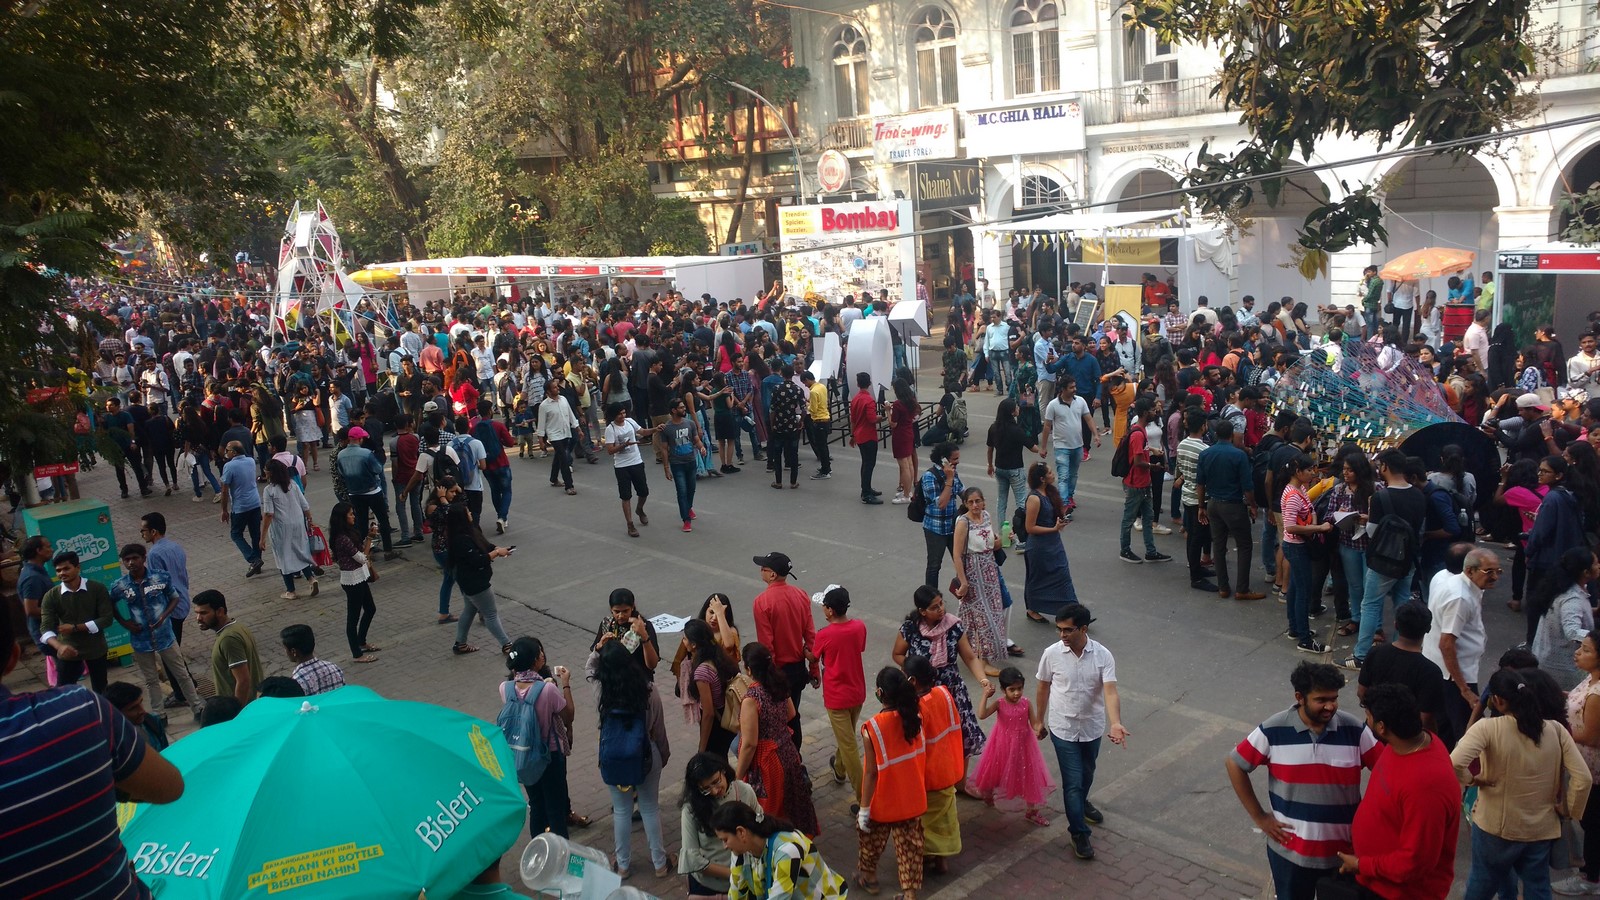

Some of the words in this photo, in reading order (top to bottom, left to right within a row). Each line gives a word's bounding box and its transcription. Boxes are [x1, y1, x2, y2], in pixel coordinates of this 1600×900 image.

[1032, 105, 1066, 120] HALL
[875, 122, 949, 141] Trade-wings
[1165, 140, 1189, 149] BUILDING
[919, 171, 952, 200] Shaina
[821, 205, 897, 231] Bombay
[59, 536, 92, 549] Bottles
[415, 780, 481, 852] Bisleri
[133, 841, 220, 879] Bisleri
[252, 871, 278, 885] HAR
[281, 861, 319, 876] PAANI
[322, 857, 335, 866] KI
[338, 847, 380, 862] BOTTLE
[271, 873, 313, 890] BISLERI
[316, 863, 356, 879] NAHIN
